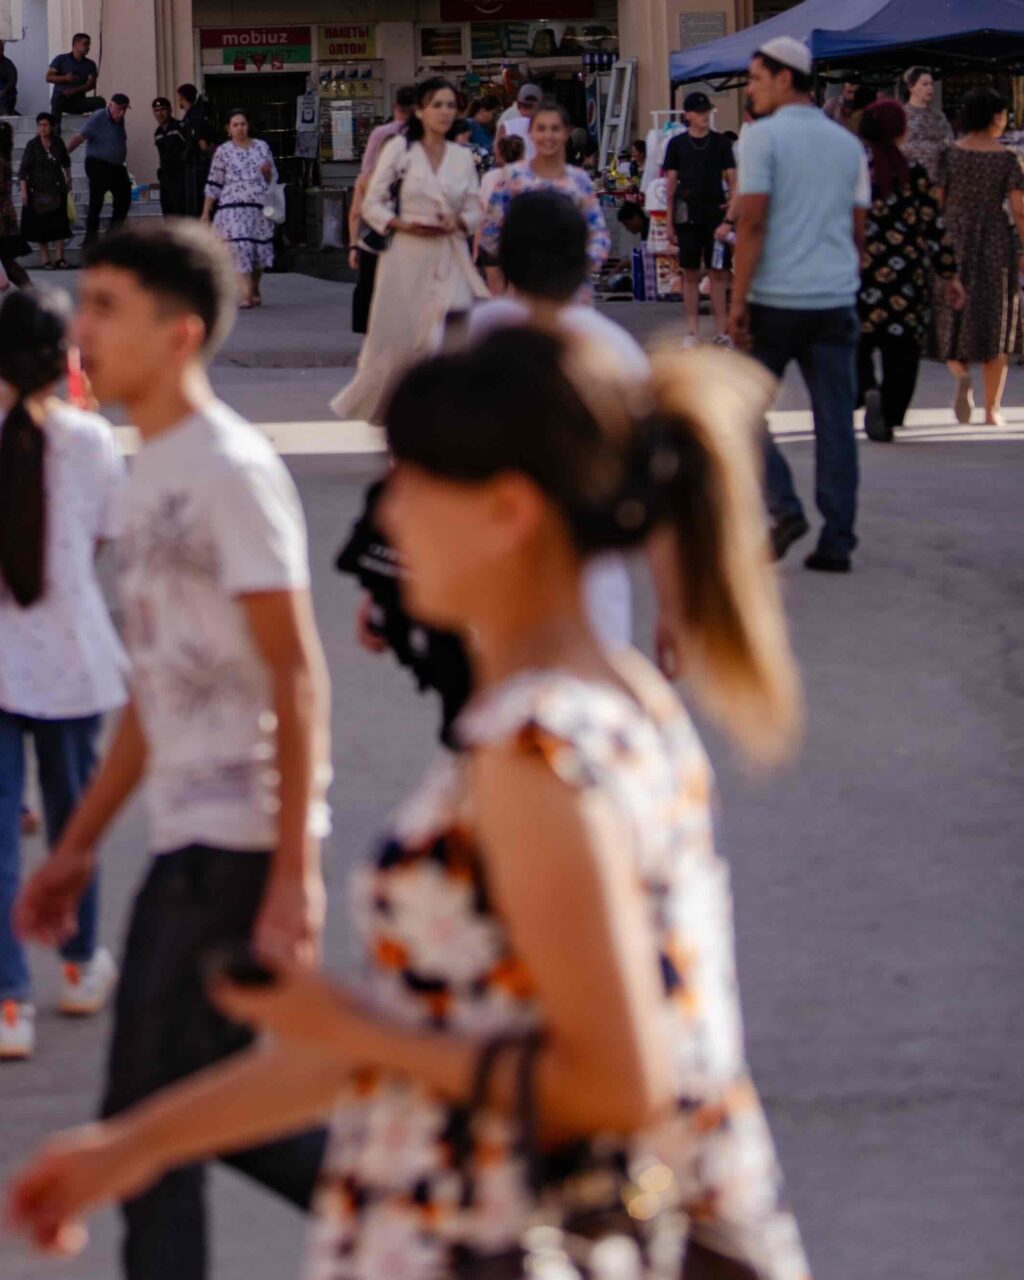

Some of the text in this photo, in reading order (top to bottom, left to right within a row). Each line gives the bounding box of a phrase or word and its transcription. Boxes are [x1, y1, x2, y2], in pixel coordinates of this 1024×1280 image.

[222, 30, 289, 45] mobiuz
[325, 26, 369, 39] ПАКЕТЫ
[329, 43, 368, 55] ОПТОМ
